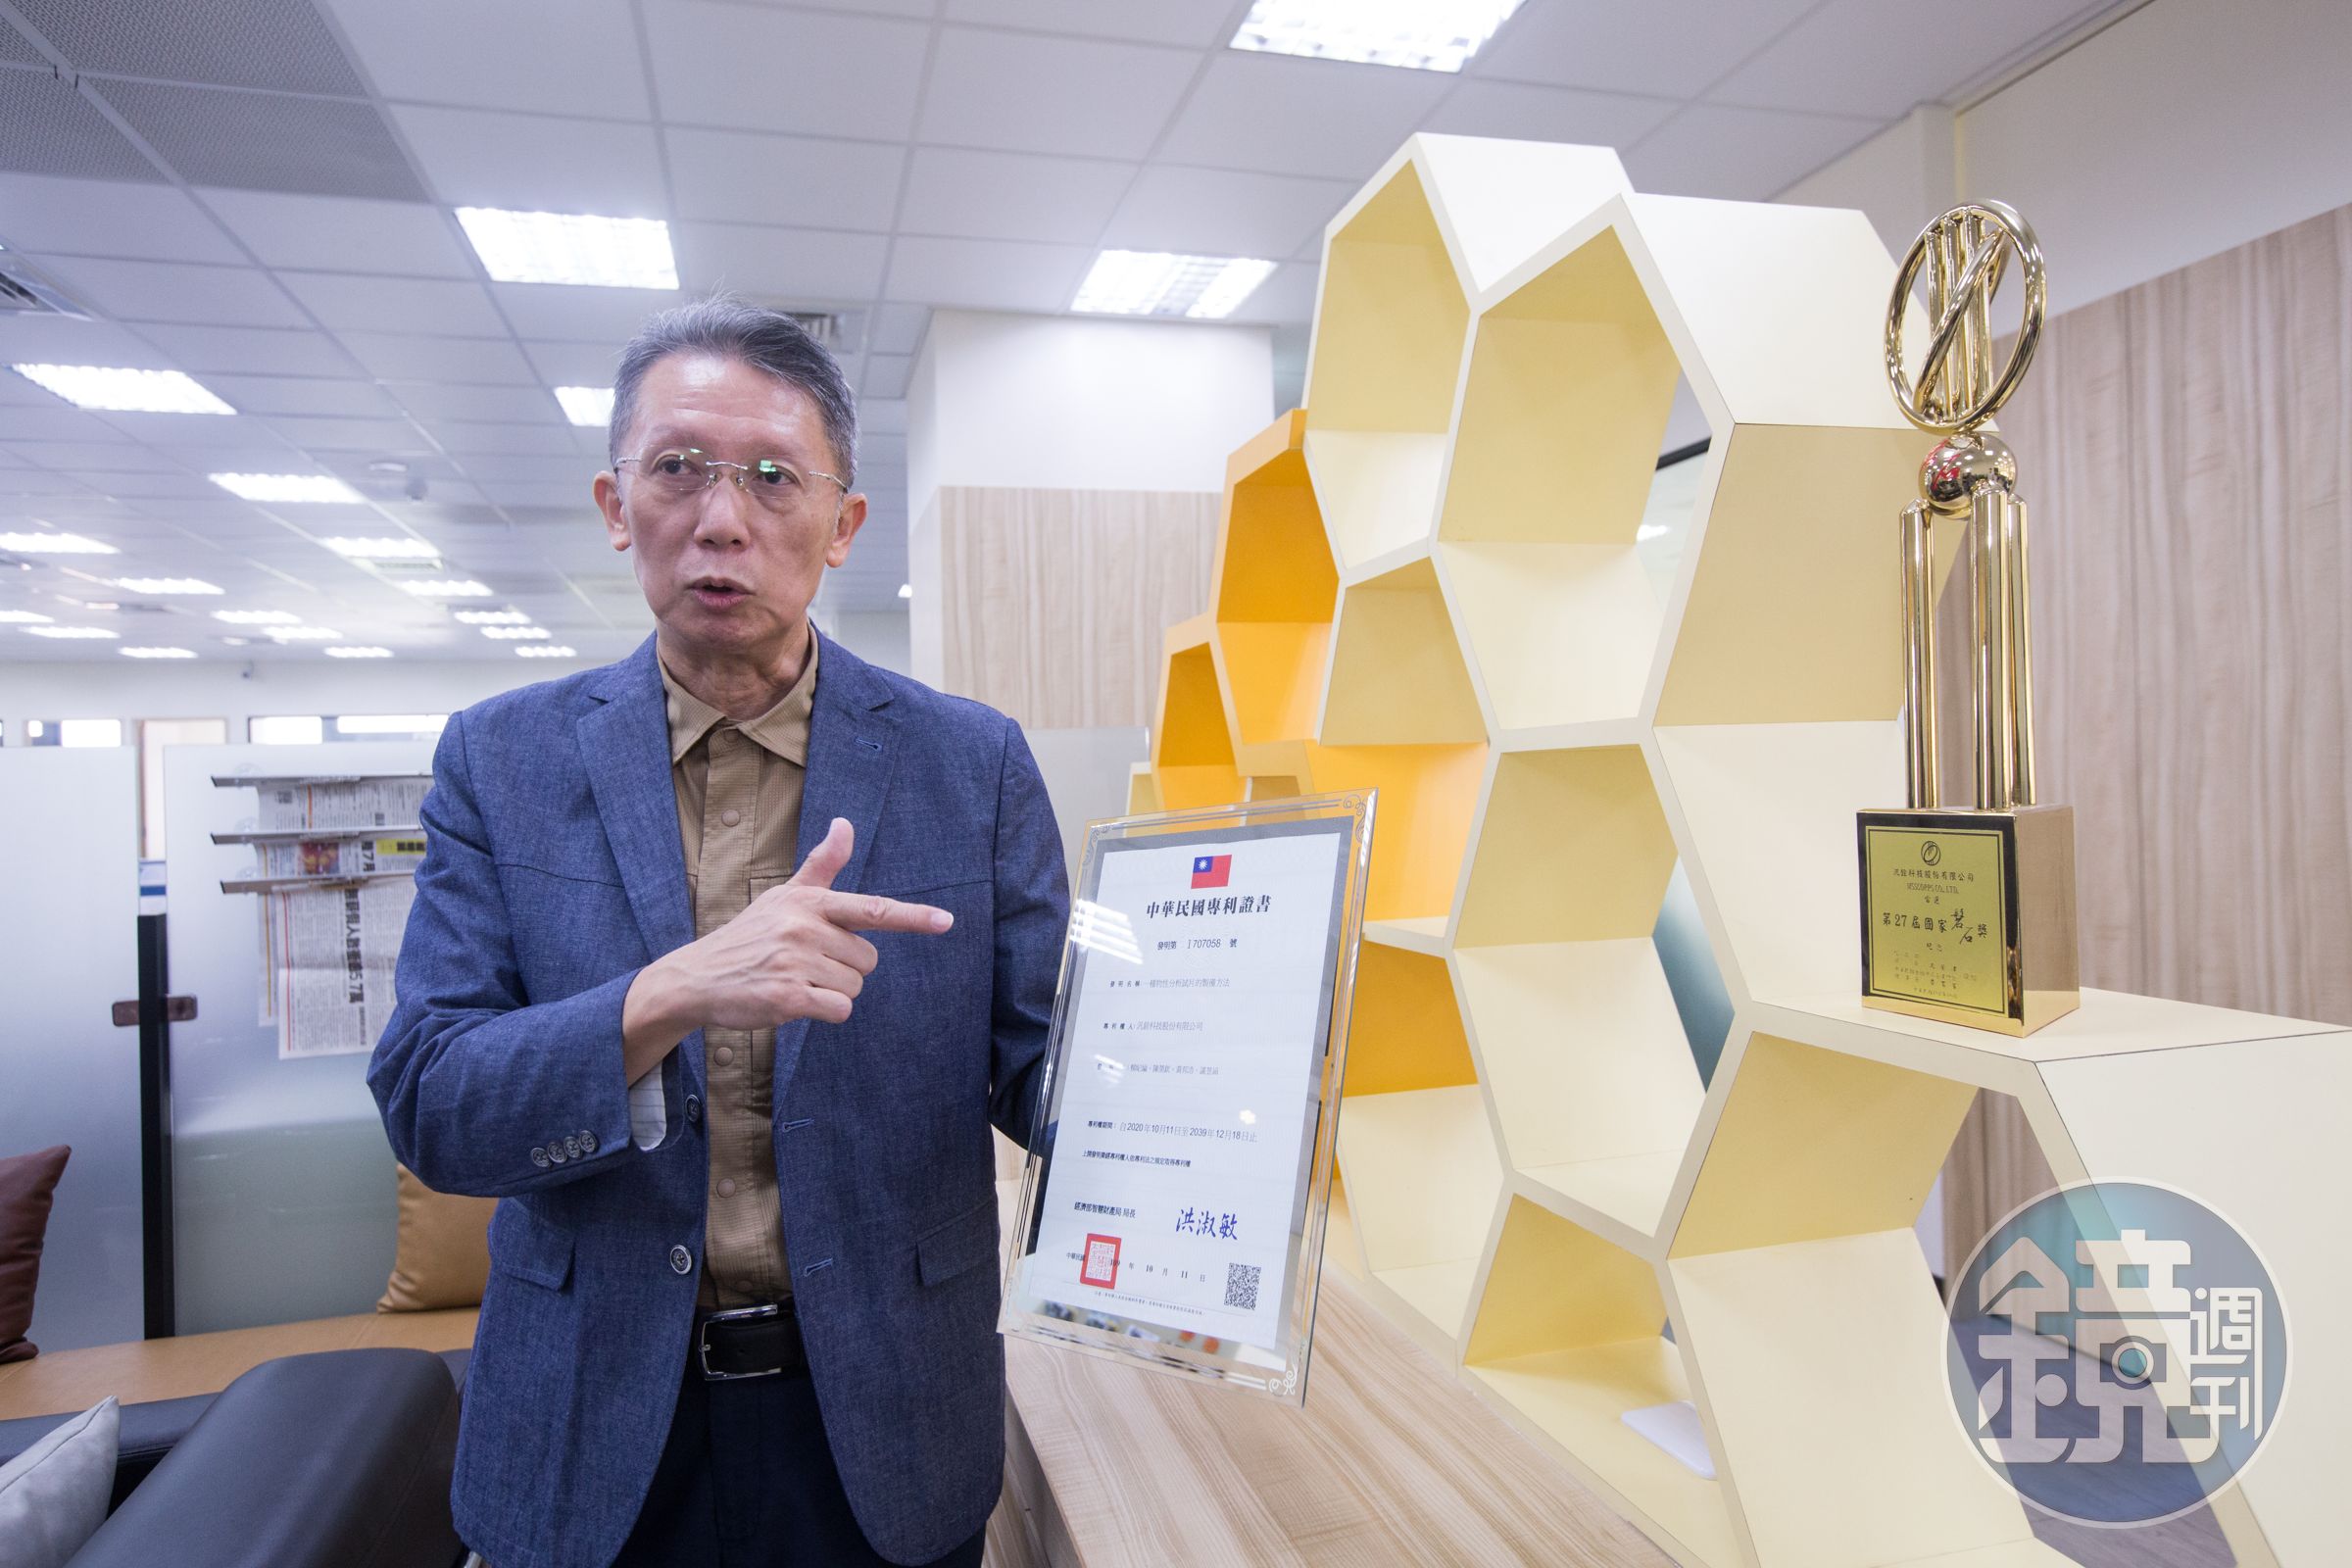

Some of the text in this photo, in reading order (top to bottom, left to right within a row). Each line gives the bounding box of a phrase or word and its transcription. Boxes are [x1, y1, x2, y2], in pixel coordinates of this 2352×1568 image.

[1146, 894, 1272, 919] 中華民國專利證書
[1176, 1206, 1239, 1241] 洪淑敏
[1146, 1264, 1153, 1273] 10
[1180, 1270, 1189, 1279] 11
